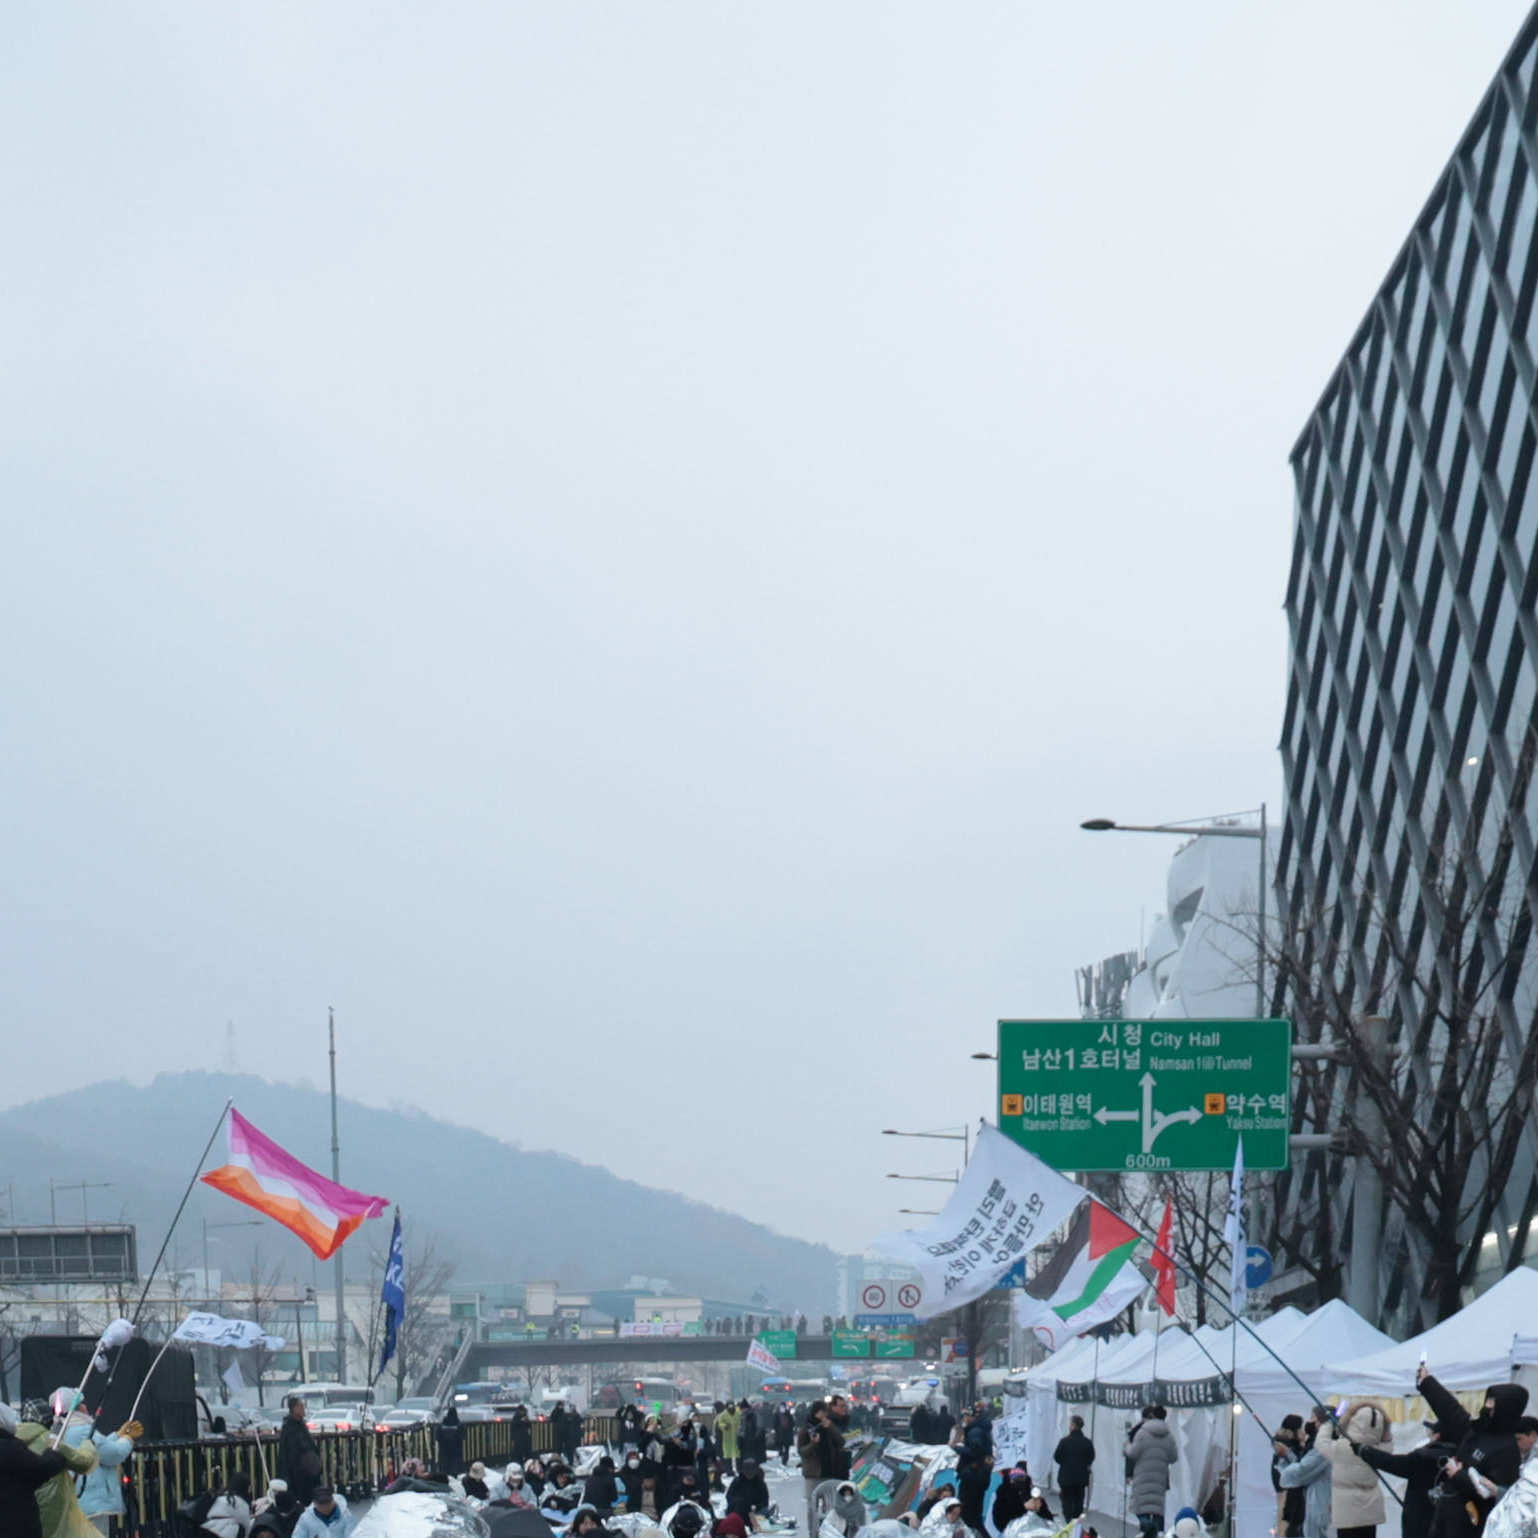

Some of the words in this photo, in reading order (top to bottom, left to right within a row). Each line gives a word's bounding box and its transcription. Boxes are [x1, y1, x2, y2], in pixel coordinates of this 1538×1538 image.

[1098, 1024, 1143, 1046] 시청
[1150, 1032, 1182, 1049] City
[1189, 1032, 1221, 1047] Hall
[1023, 1049, 1141, 1071] 남산1호터널
[1149, 1056, 1195, 1071] Namsan
[1216, 1056, 1253, 1071] Tunnel
[1023, 1093, 1093, 1115] 이태원역
[1226, 1092, 1287, 1115] 약수역
[1059, 1116, 1092, 1131] Station
[1226, 1117, 1254, 1131] Yaksu
[1254, 1116, 1287, 1131] Station
[1125, 1154, 1171, 1169] 600m
